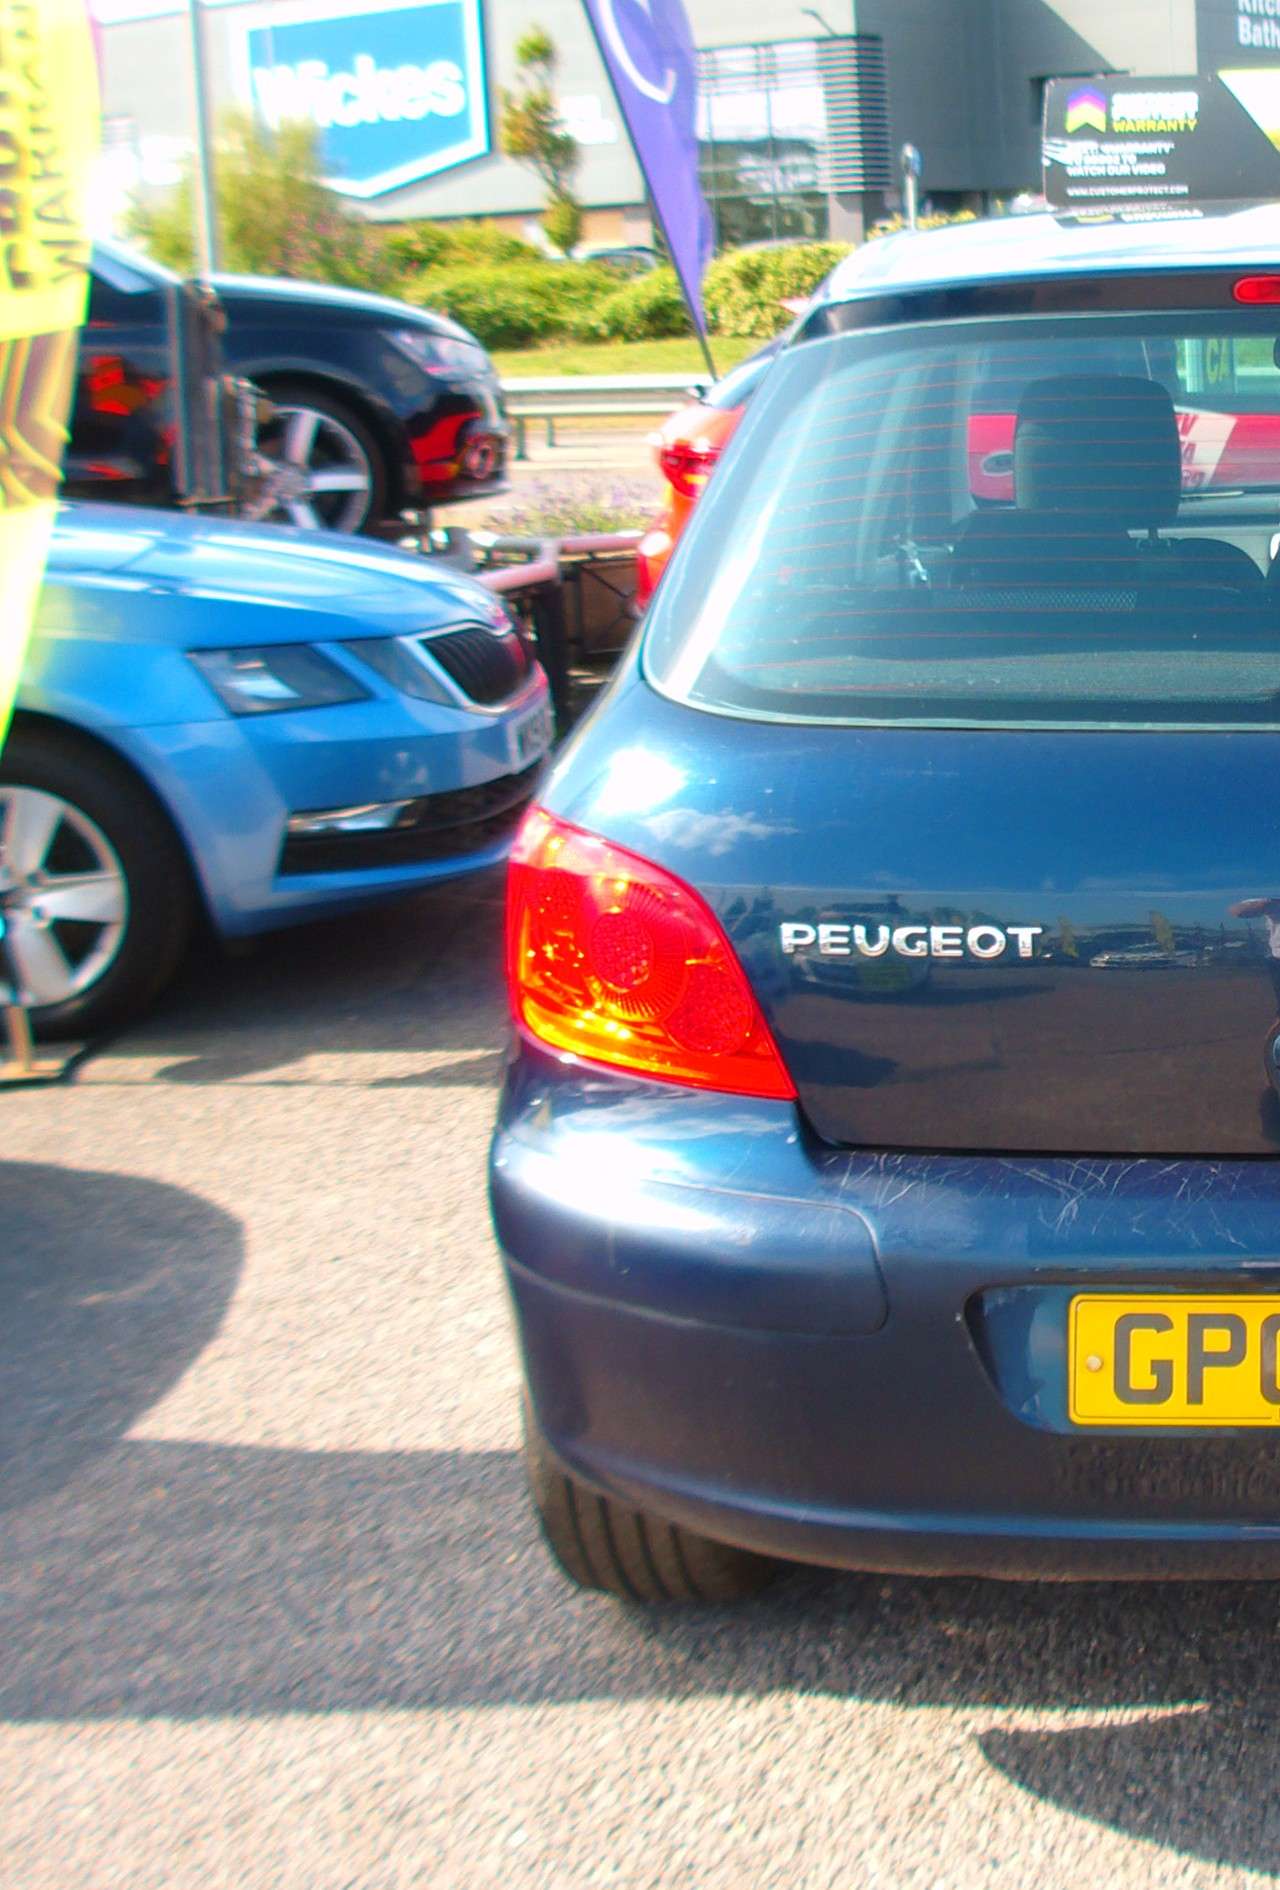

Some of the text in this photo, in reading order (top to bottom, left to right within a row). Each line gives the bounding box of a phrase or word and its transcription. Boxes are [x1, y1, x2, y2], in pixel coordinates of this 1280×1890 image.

[253, 54, 465, 131] Wickes
[1113, 119, 1197, 132] WARRANTY
[1107, 165, 1131, 176] OUR
[1131, 163, 1166, 175] VIDEO
[780, 922, 1042, 958] PEUGEOT
